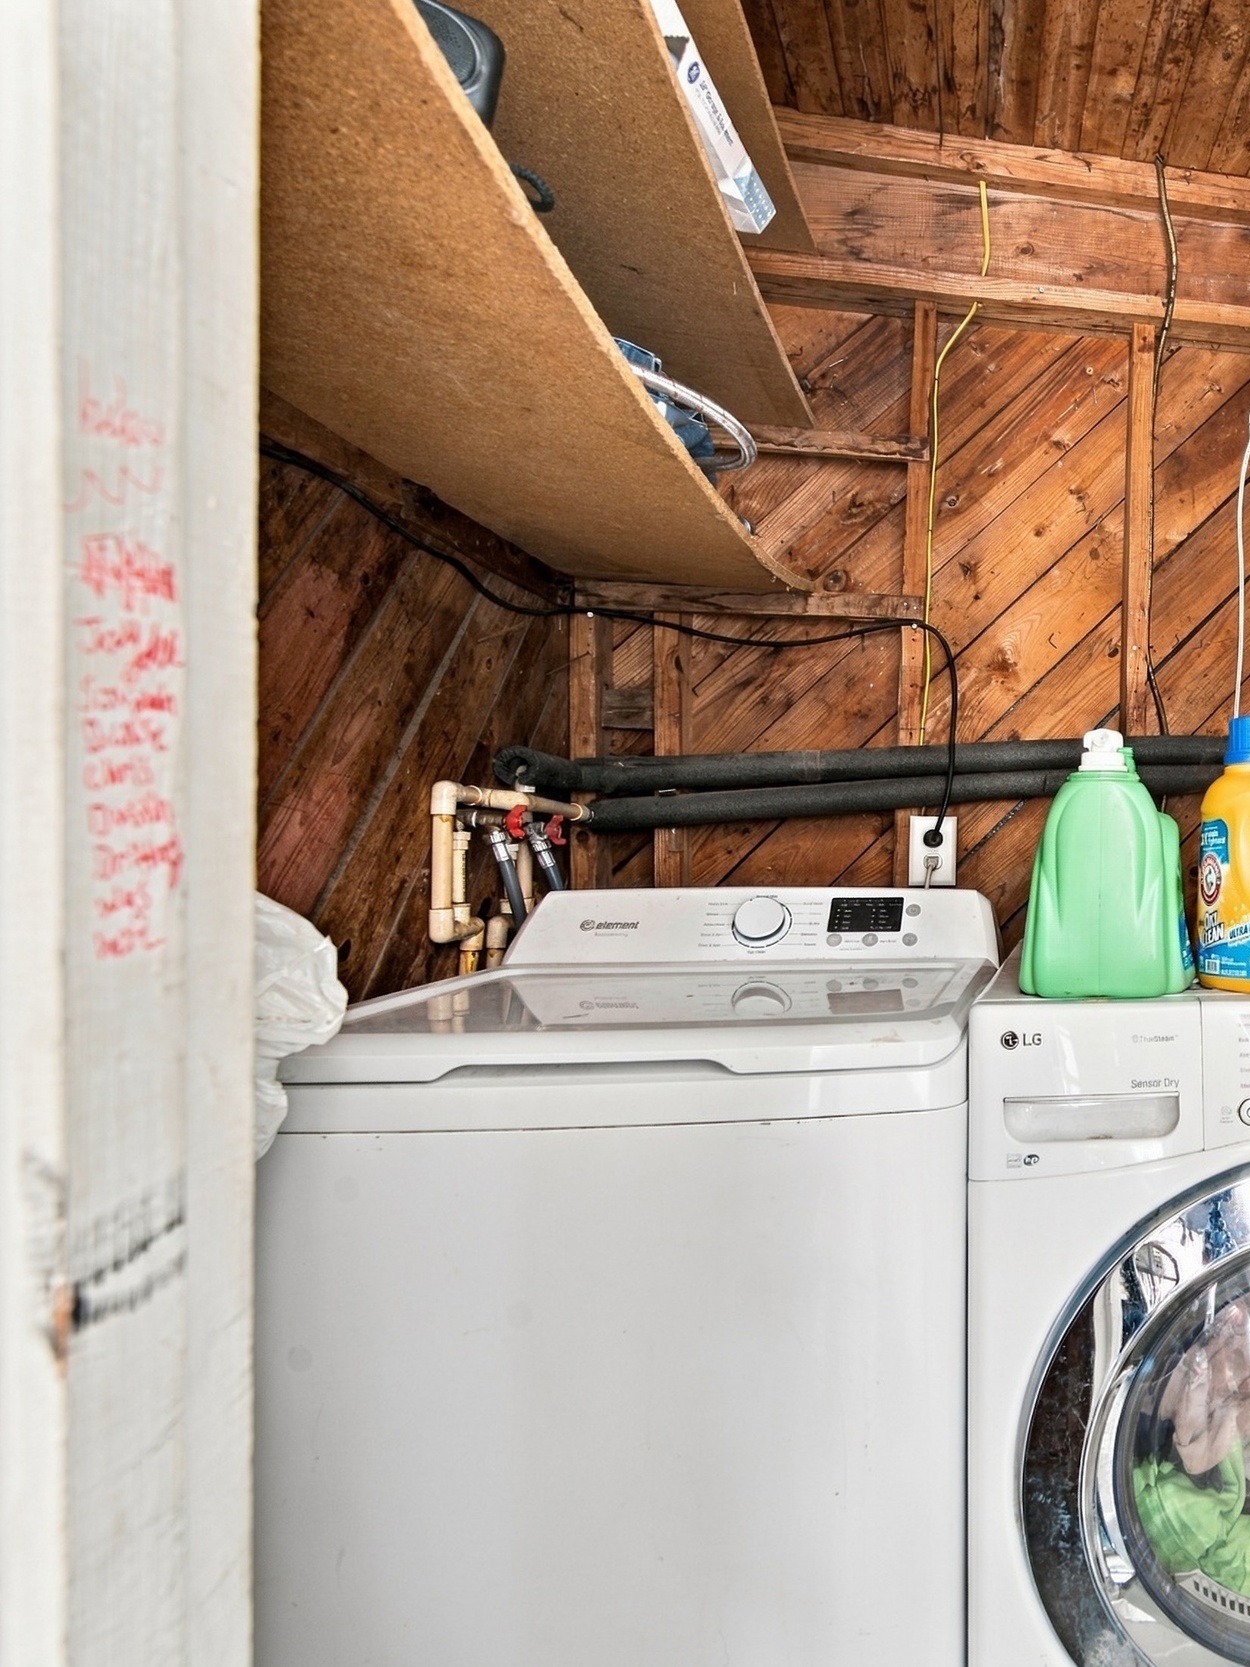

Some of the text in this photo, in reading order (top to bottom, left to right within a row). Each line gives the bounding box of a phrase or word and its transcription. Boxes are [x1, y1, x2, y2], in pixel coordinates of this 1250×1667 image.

[595, 921, 640, 930] element
[1229, 925, 1248, 939] ULTRA
[1023, 1033, 1042, 1047] LG
[1131, 1077, 1180, 1089] Sensor Dry
